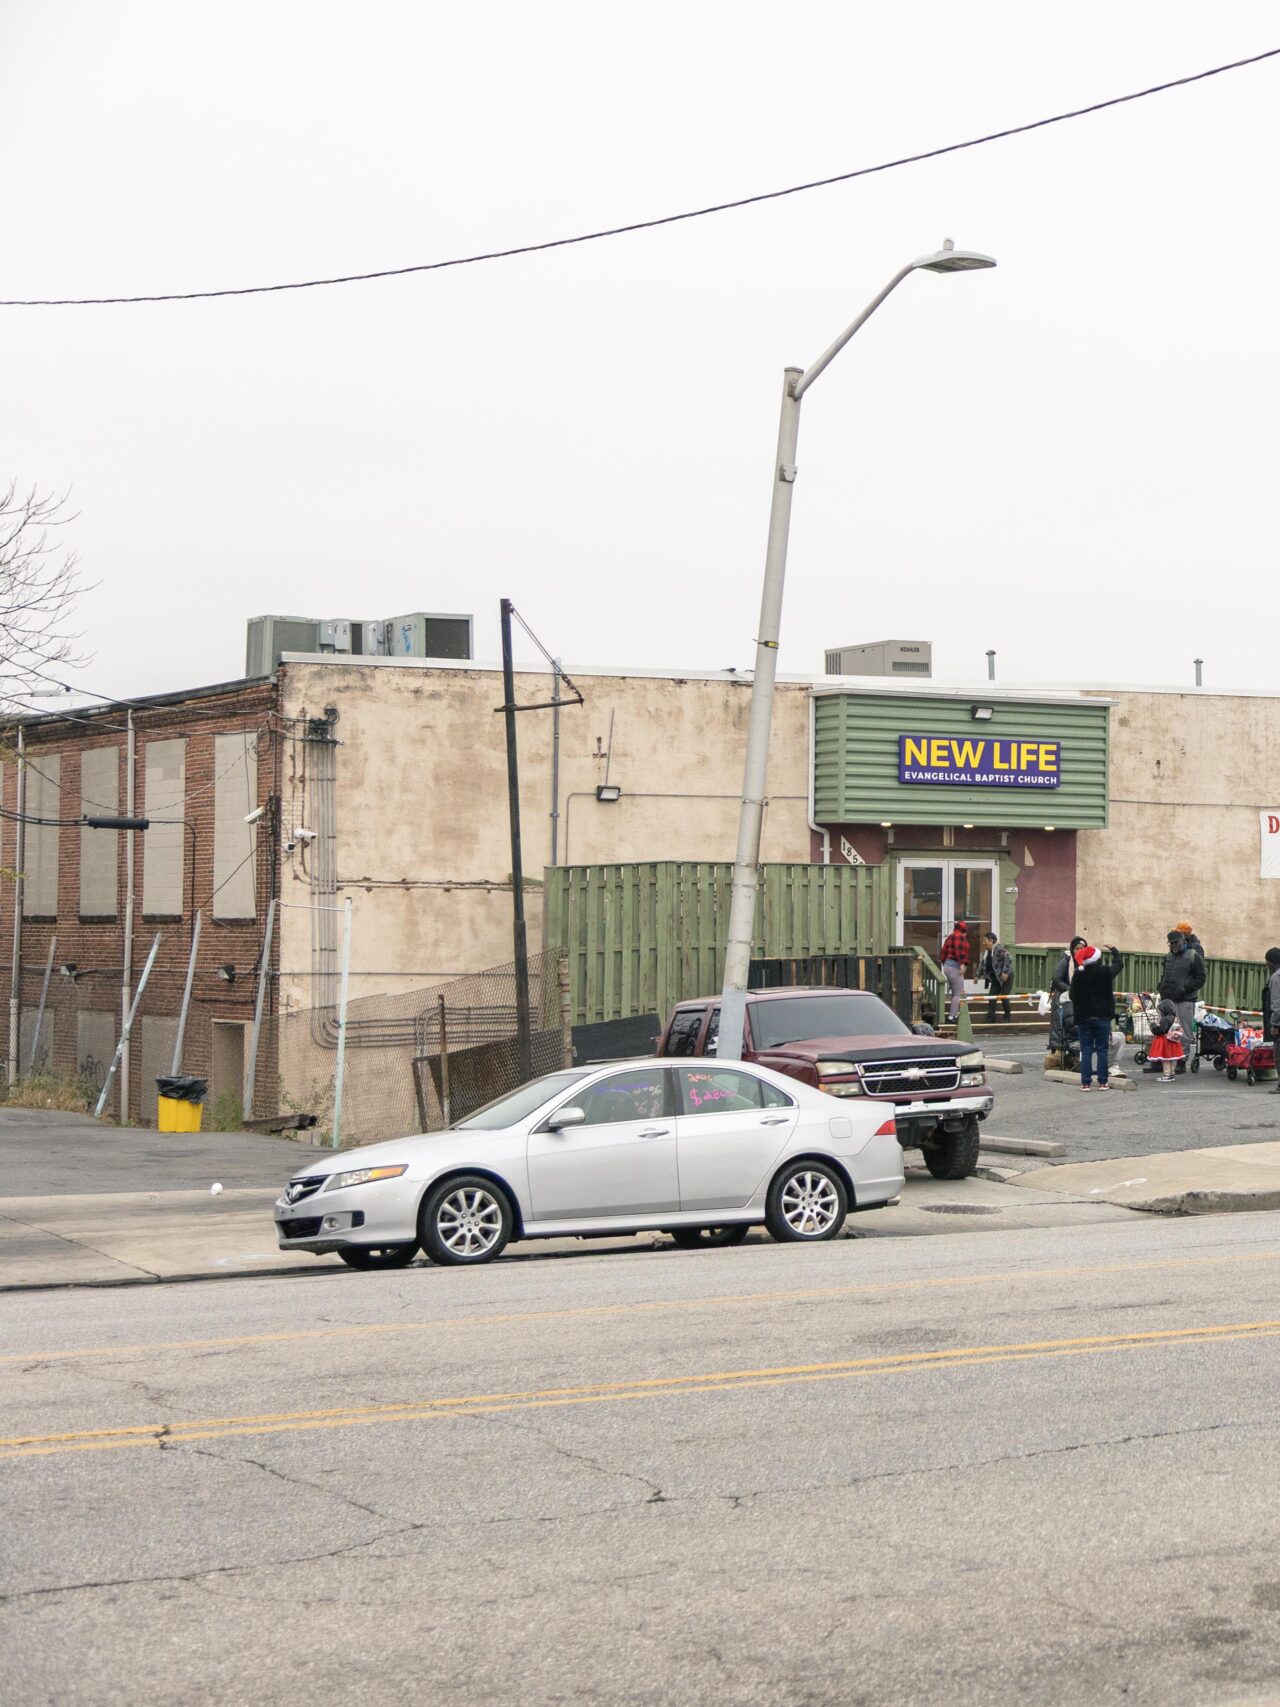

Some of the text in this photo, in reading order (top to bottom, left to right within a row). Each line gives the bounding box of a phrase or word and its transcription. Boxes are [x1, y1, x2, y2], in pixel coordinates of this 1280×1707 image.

[904, 738, 1057, 771] NEW LIFE
[904, 771, 1057, 784] EVANGELICAL BAPTIST CHURCH
